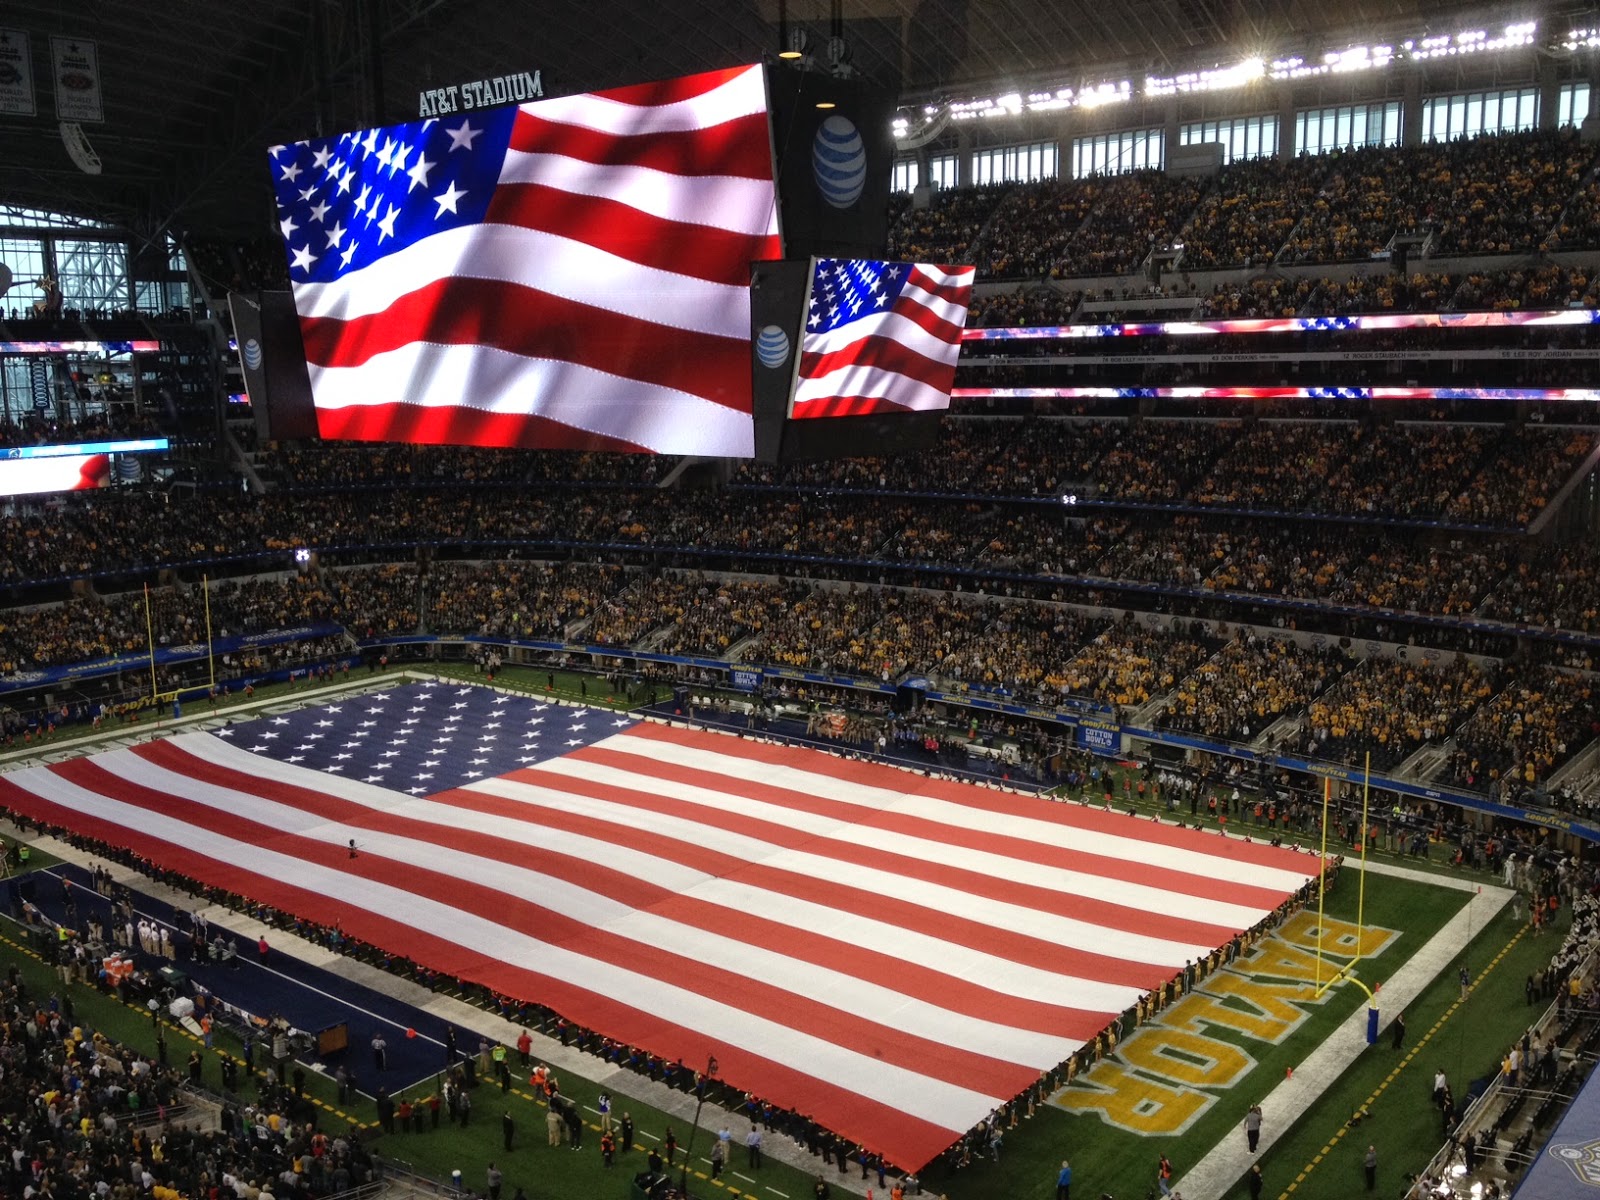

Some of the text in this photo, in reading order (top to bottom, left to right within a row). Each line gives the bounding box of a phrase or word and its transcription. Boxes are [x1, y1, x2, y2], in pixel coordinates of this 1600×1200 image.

[419, 69, 544, 118] AT&T STADIUM
[734, 671, 757, 681] COTTON
[1078, 719, 1120, 733] GOODYEAR
[1085, 728, 1113, 740] COTTON
[1085, 735, 1106, 746] BOWL
[1307, 764, 1347, 778] GOODYEAR
[1524, 812, 1571, 829] GOODYEAR
[1044, 909, 1404, 1139] BAYLOR
